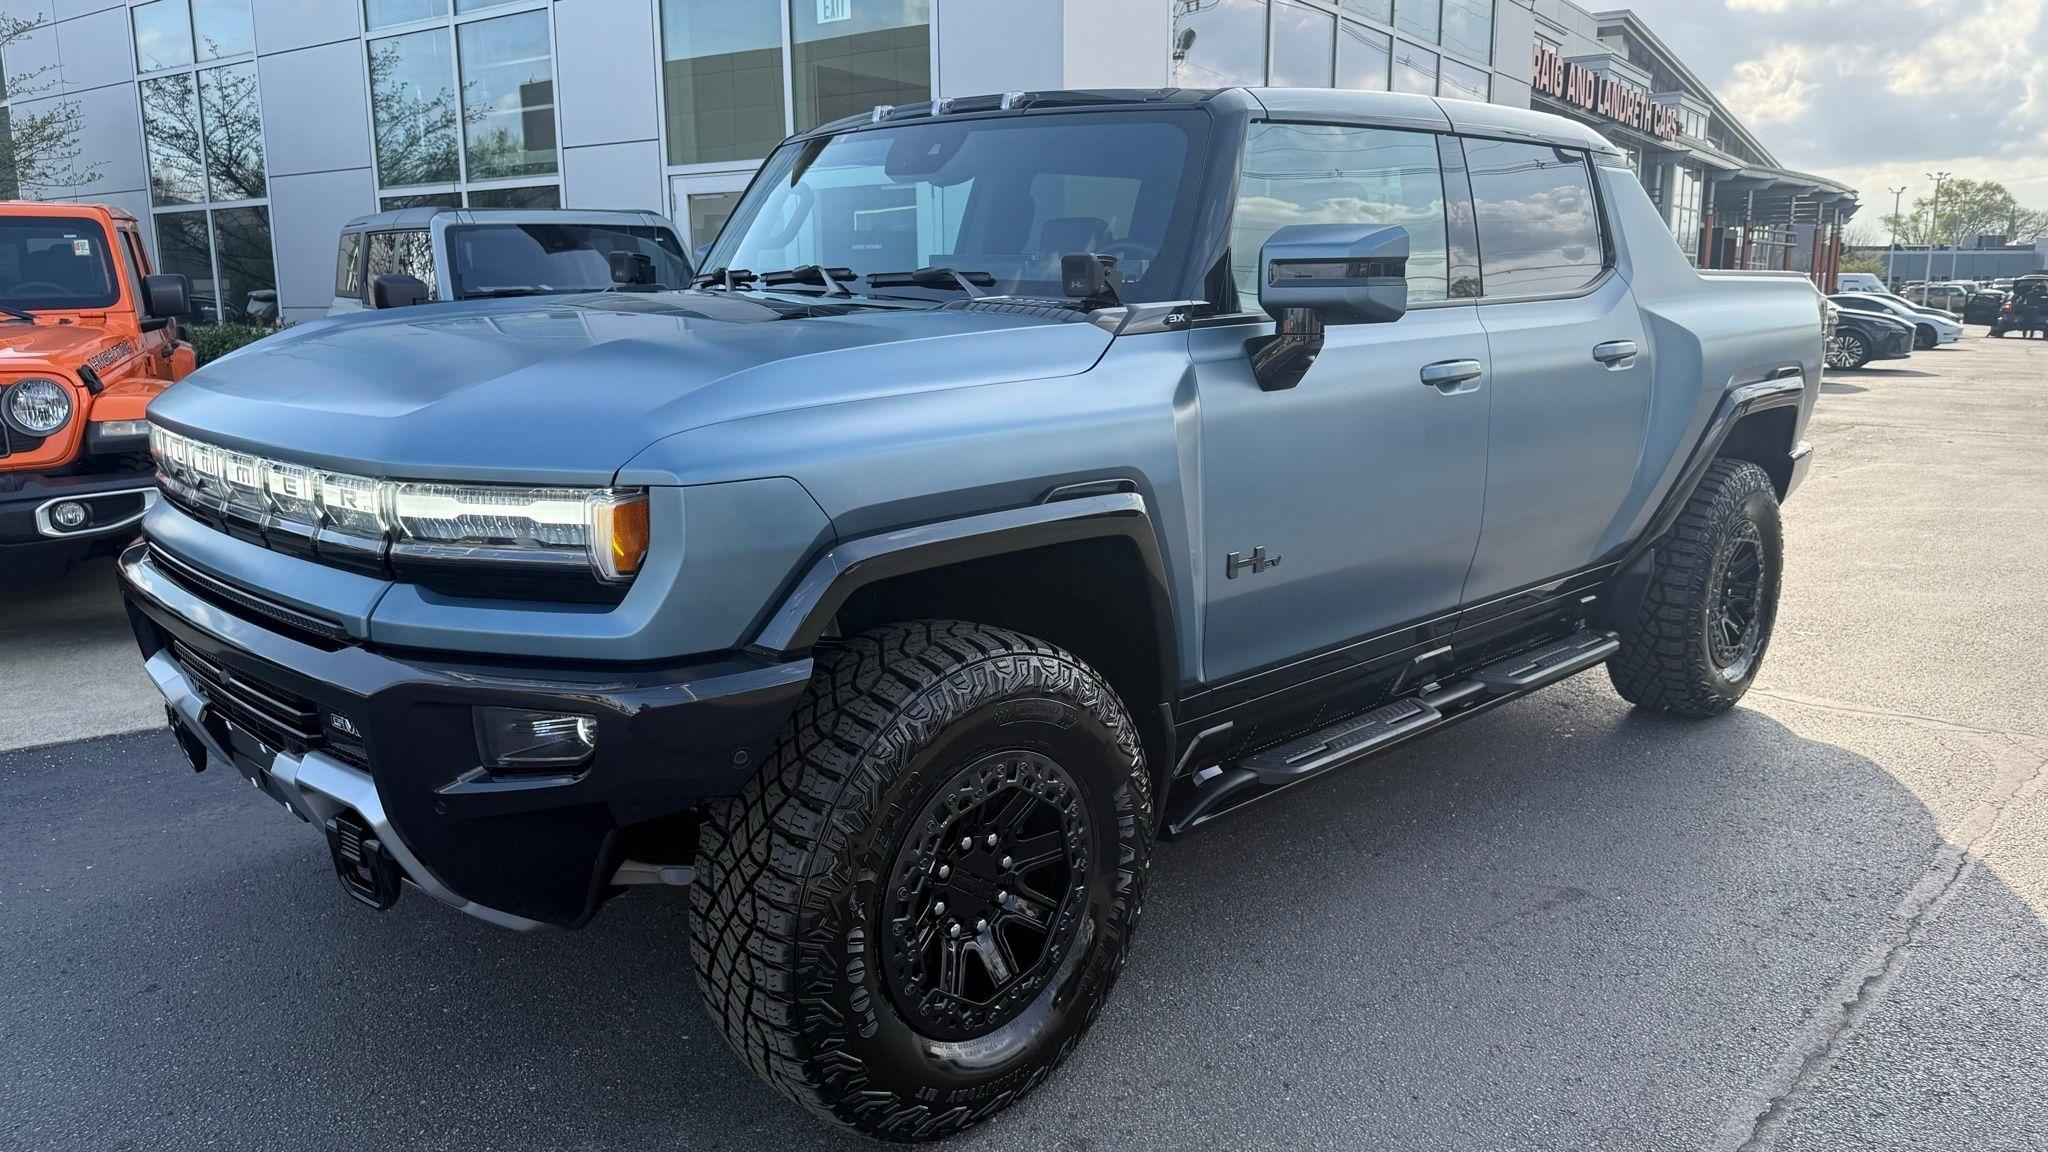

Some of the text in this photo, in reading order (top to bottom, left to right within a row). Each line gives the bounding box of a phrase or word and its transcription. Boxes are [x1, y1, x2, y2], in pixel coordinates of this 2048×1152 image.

[824, 0, 844, 20] EXIT
[1531, 43, 1677, 141] RAIG AND LANDRETH CARS
[1168, 313, 1186, 323] 3X
